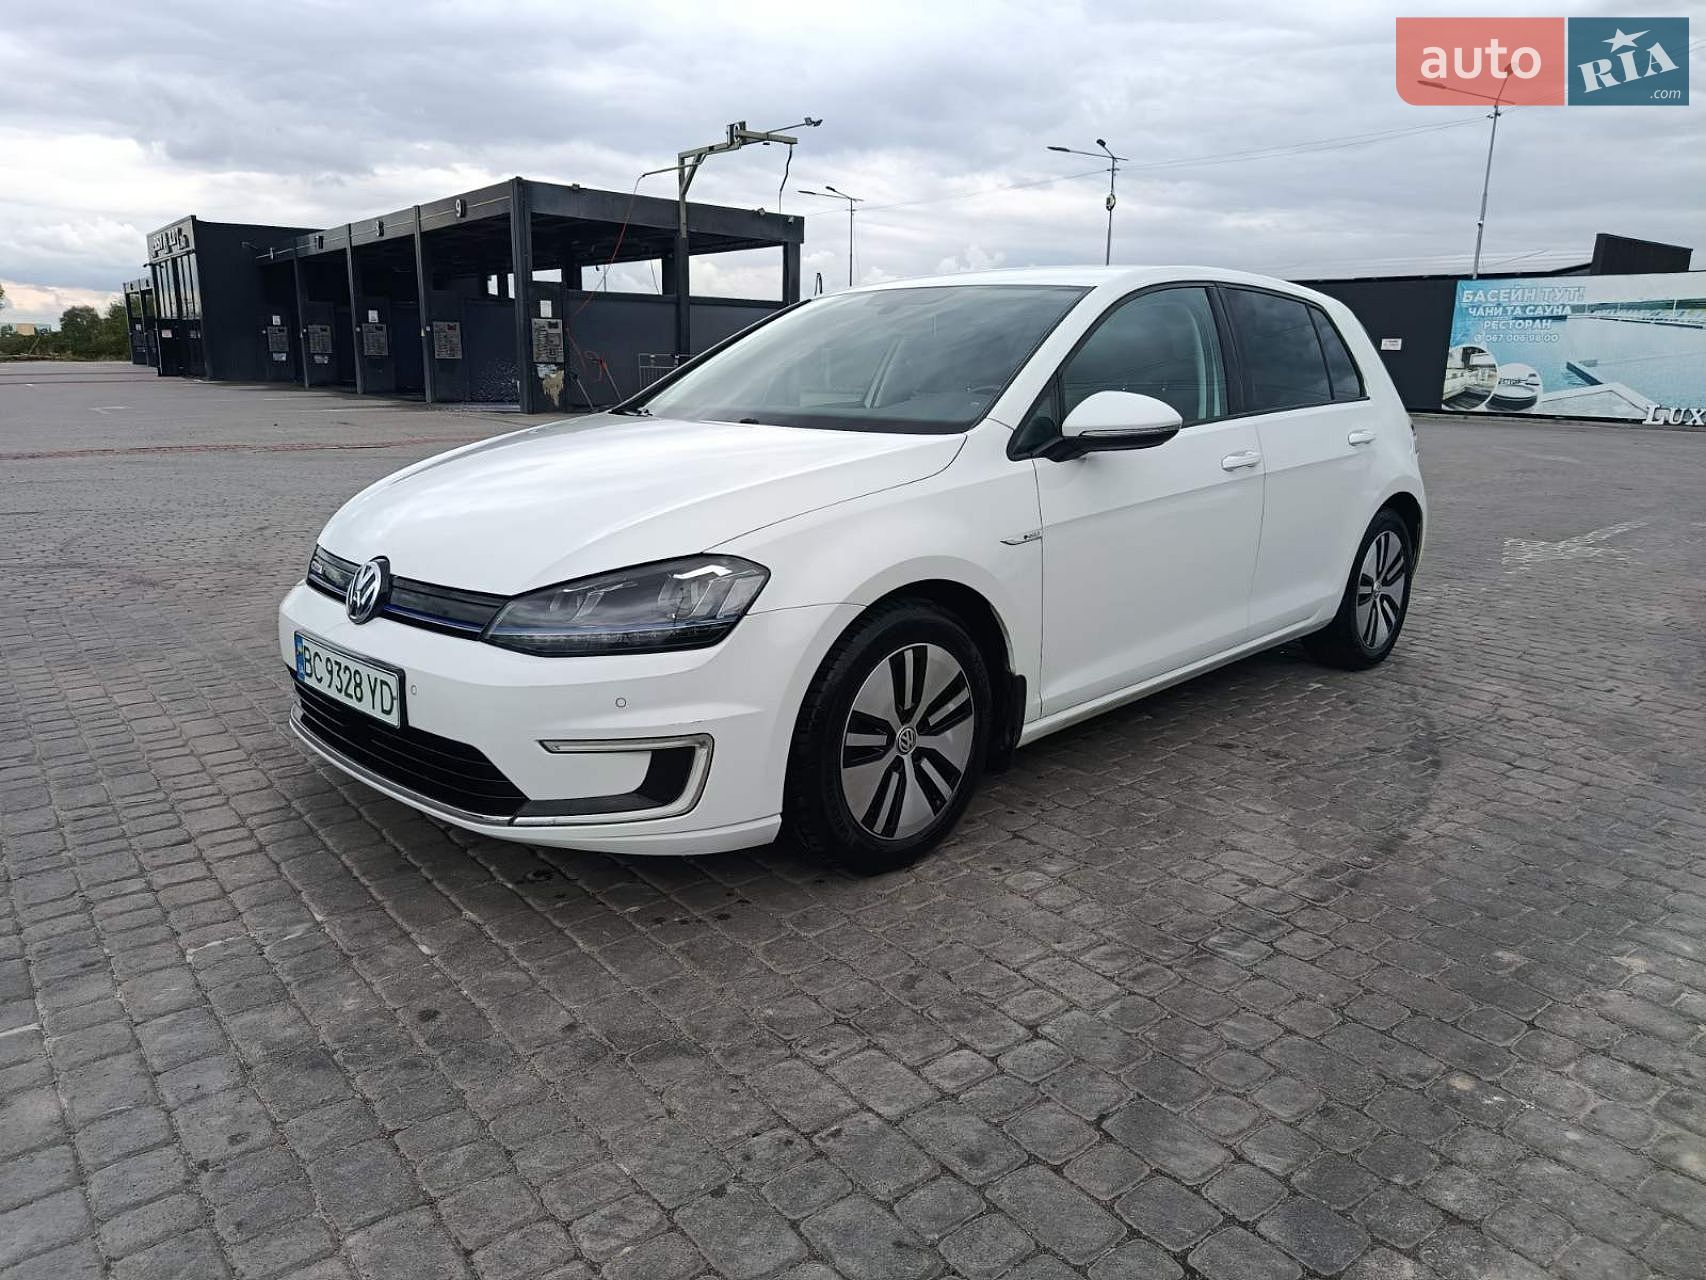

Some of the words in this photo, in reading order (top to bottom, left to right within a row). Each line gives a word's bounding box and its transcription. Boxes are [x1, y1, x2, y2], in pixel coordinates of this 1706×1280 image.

[1462, 285, 1536, 303] БАСЕЙН
[1541, 286, 1585, 302] ТУТ!
[1468, 306, 1502, 317] ЧАНИ
[1506, 306, 1522, 316] ТА
[1525, 305, 1572, 316] САУНА
[1483, 319, 1552, 330] РЕСТОРАН
[303, 645, 323, 684] BC
[325, 657, 364, 702] 9328
[367, 674, 395, 716] YD
